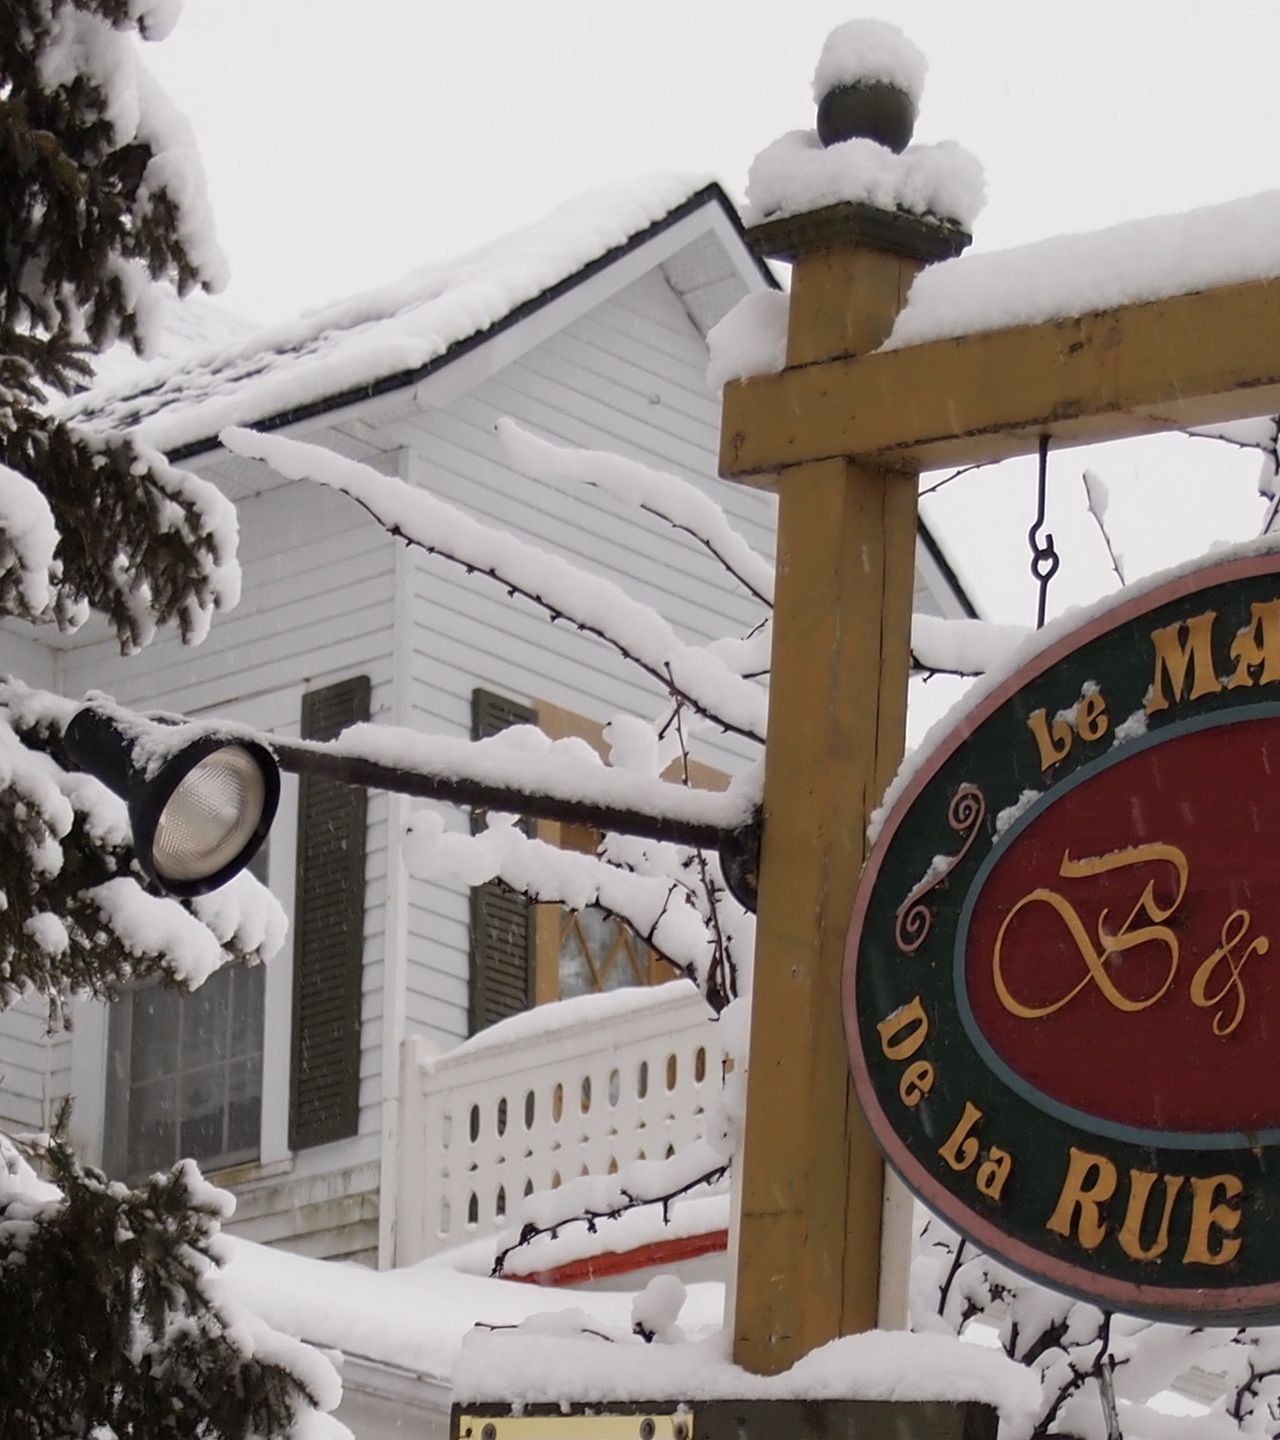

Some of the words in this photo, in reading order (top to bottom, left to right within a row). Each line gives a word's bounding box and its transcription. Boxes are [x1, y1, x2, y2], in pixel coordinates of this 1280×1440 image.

[1028, 686, 1109, 773] Le
[876, 995, 937, 1108] De
[938, 1101, 1013, 1202] La
[1046, 1145, 1244, 1267] RUE
